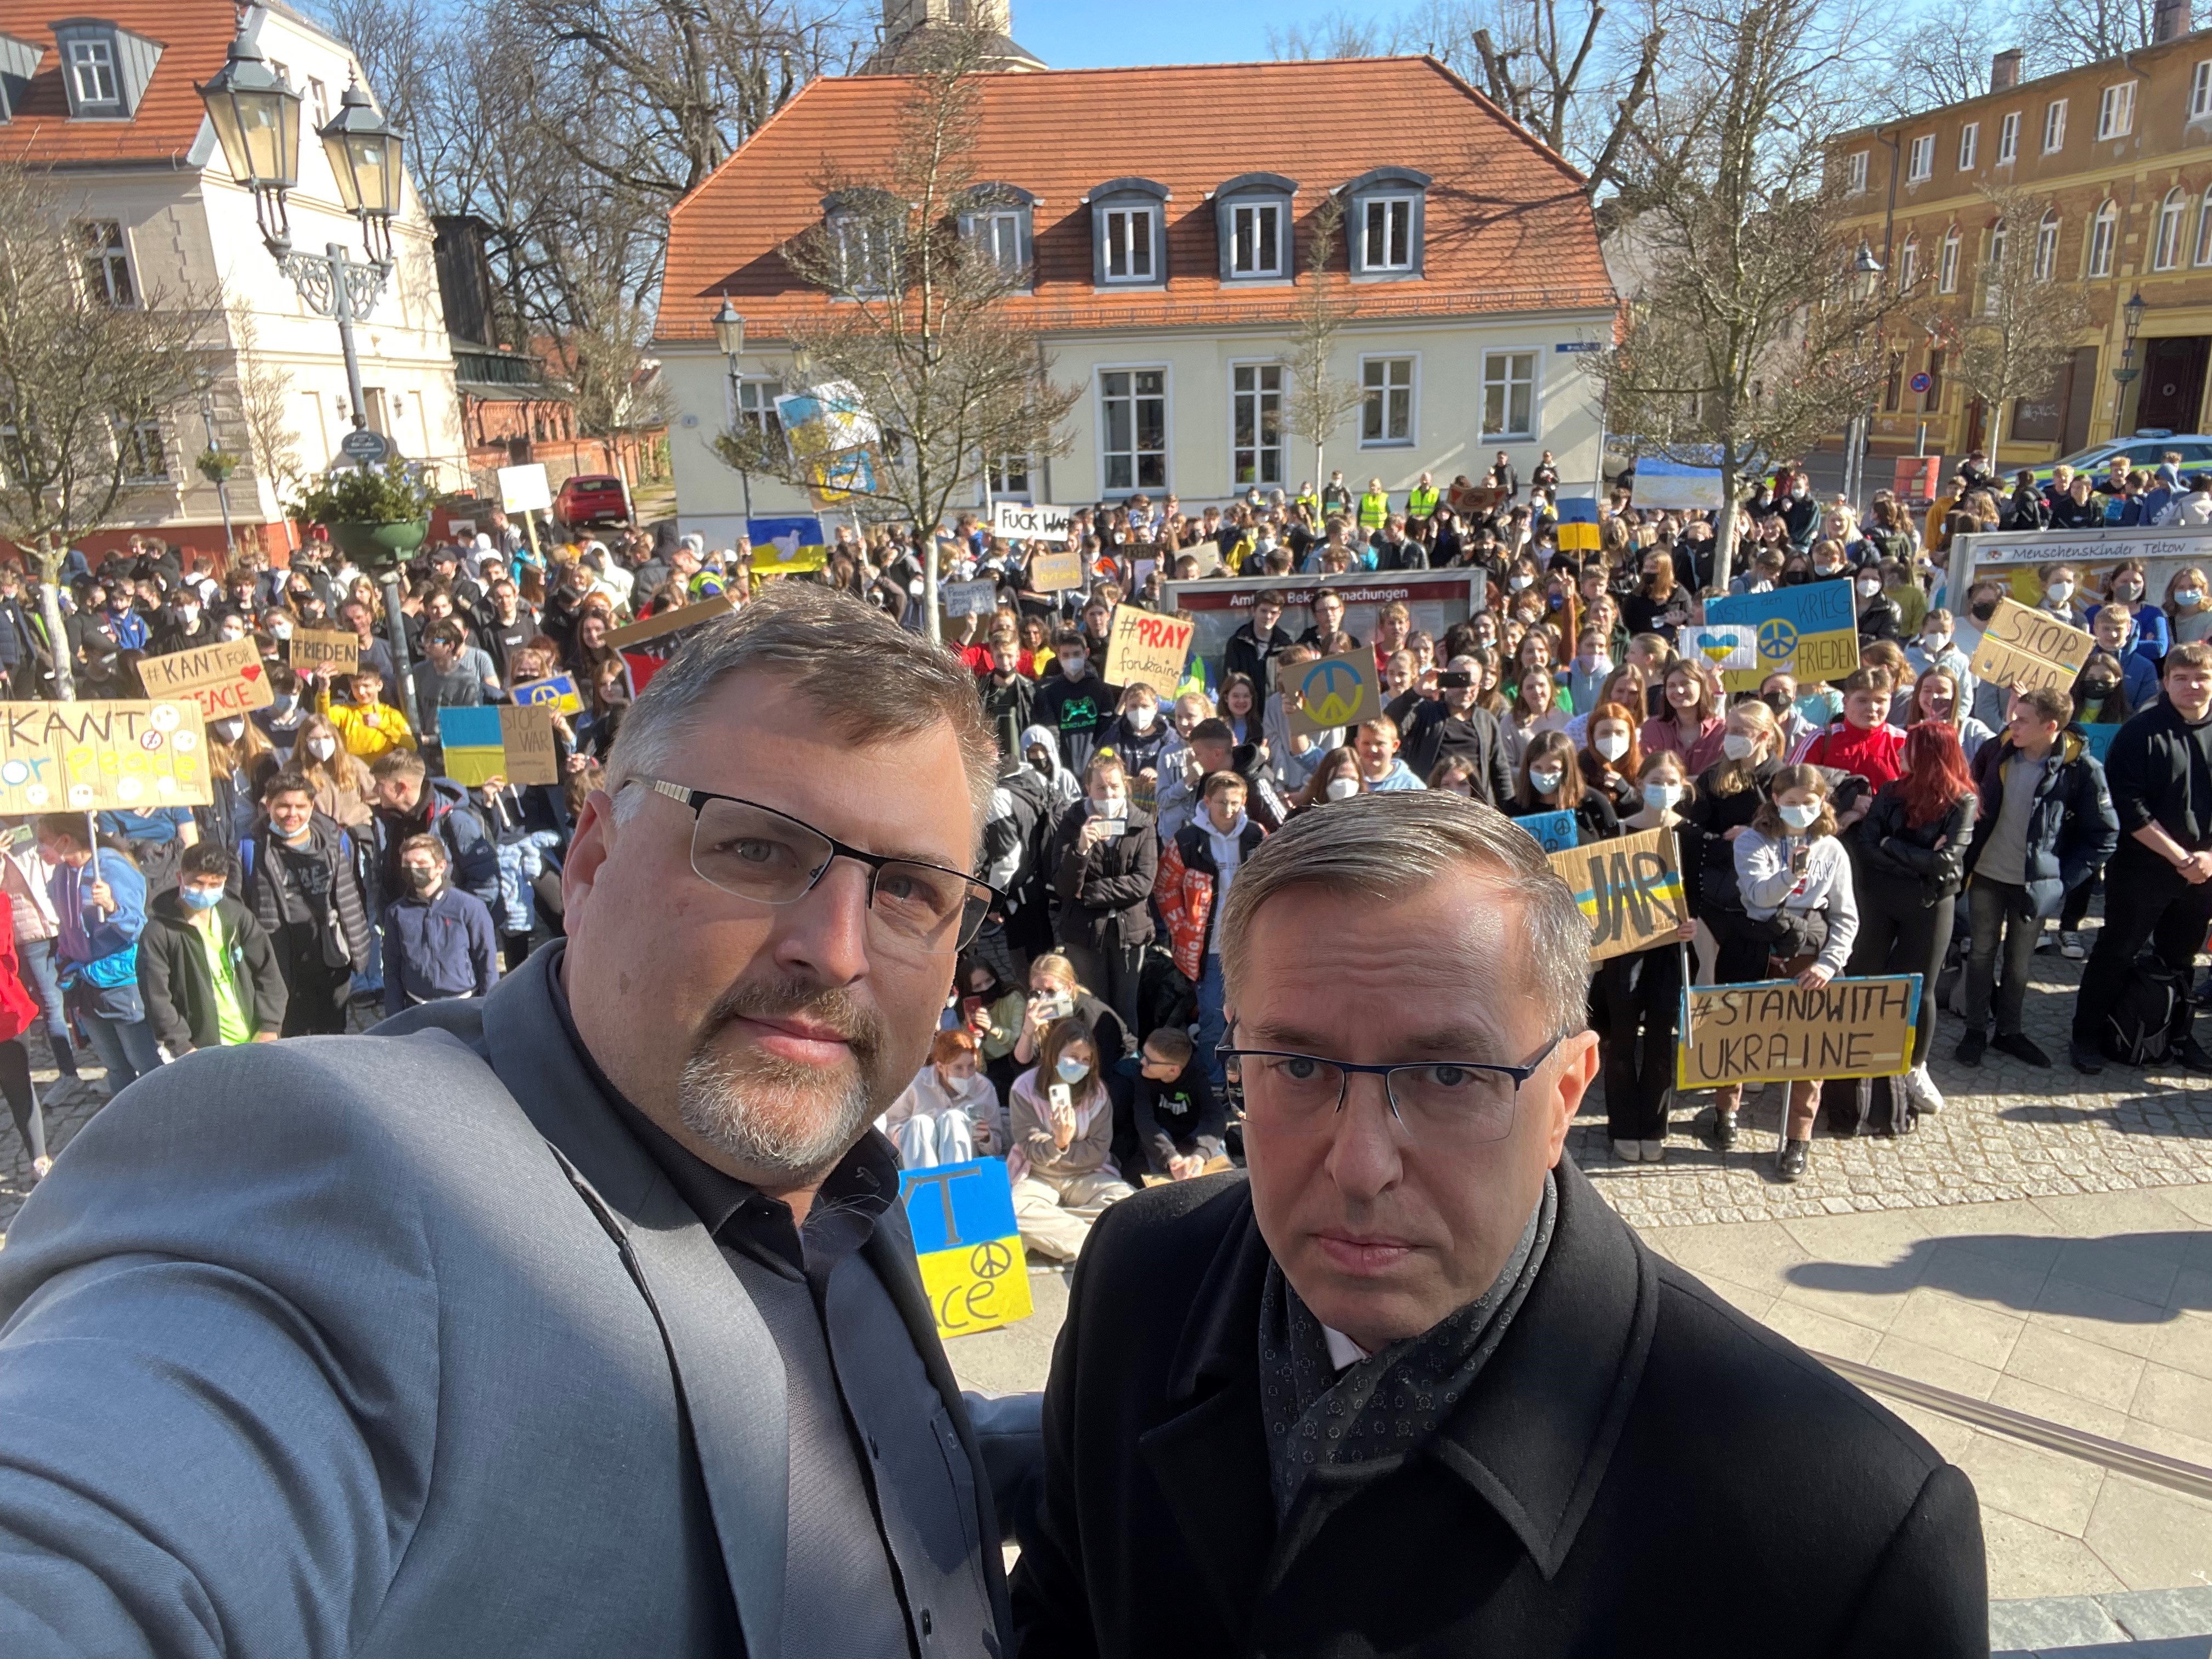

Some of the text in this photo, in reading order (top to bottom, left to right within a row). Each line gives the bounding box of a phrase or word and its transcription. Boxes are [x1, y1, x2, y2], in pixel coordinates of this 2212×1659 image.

[1002, 509, 1039, 531] FUCK
[2143, 541, 2186, 554] Teltow
[1287, 588, 1409, 604] Bekmachungen
[1759, 596, 1782, 606] den
[1797, 585, 1852, 624] KRIEG
[1119, 614, 1190, 650] #PRAY
[2003, 610, 2079, 662] STOP
[147, 647, 252, 684] #KANT FOR
[292, 640, 356, 663] FRIEDEN
[1798, 636, 1858, 676] FRIEDEN
[179, 682, 254, 716] EACE
[0, 708, 145, 748] KANT
[500, 707, 539, 731] STOP
[67, 747, 196, 782] Peace
[1691, 983, 1910, 1025] #STANDWITH
[1699, 1031, 1874, 1080] UKRAINE
